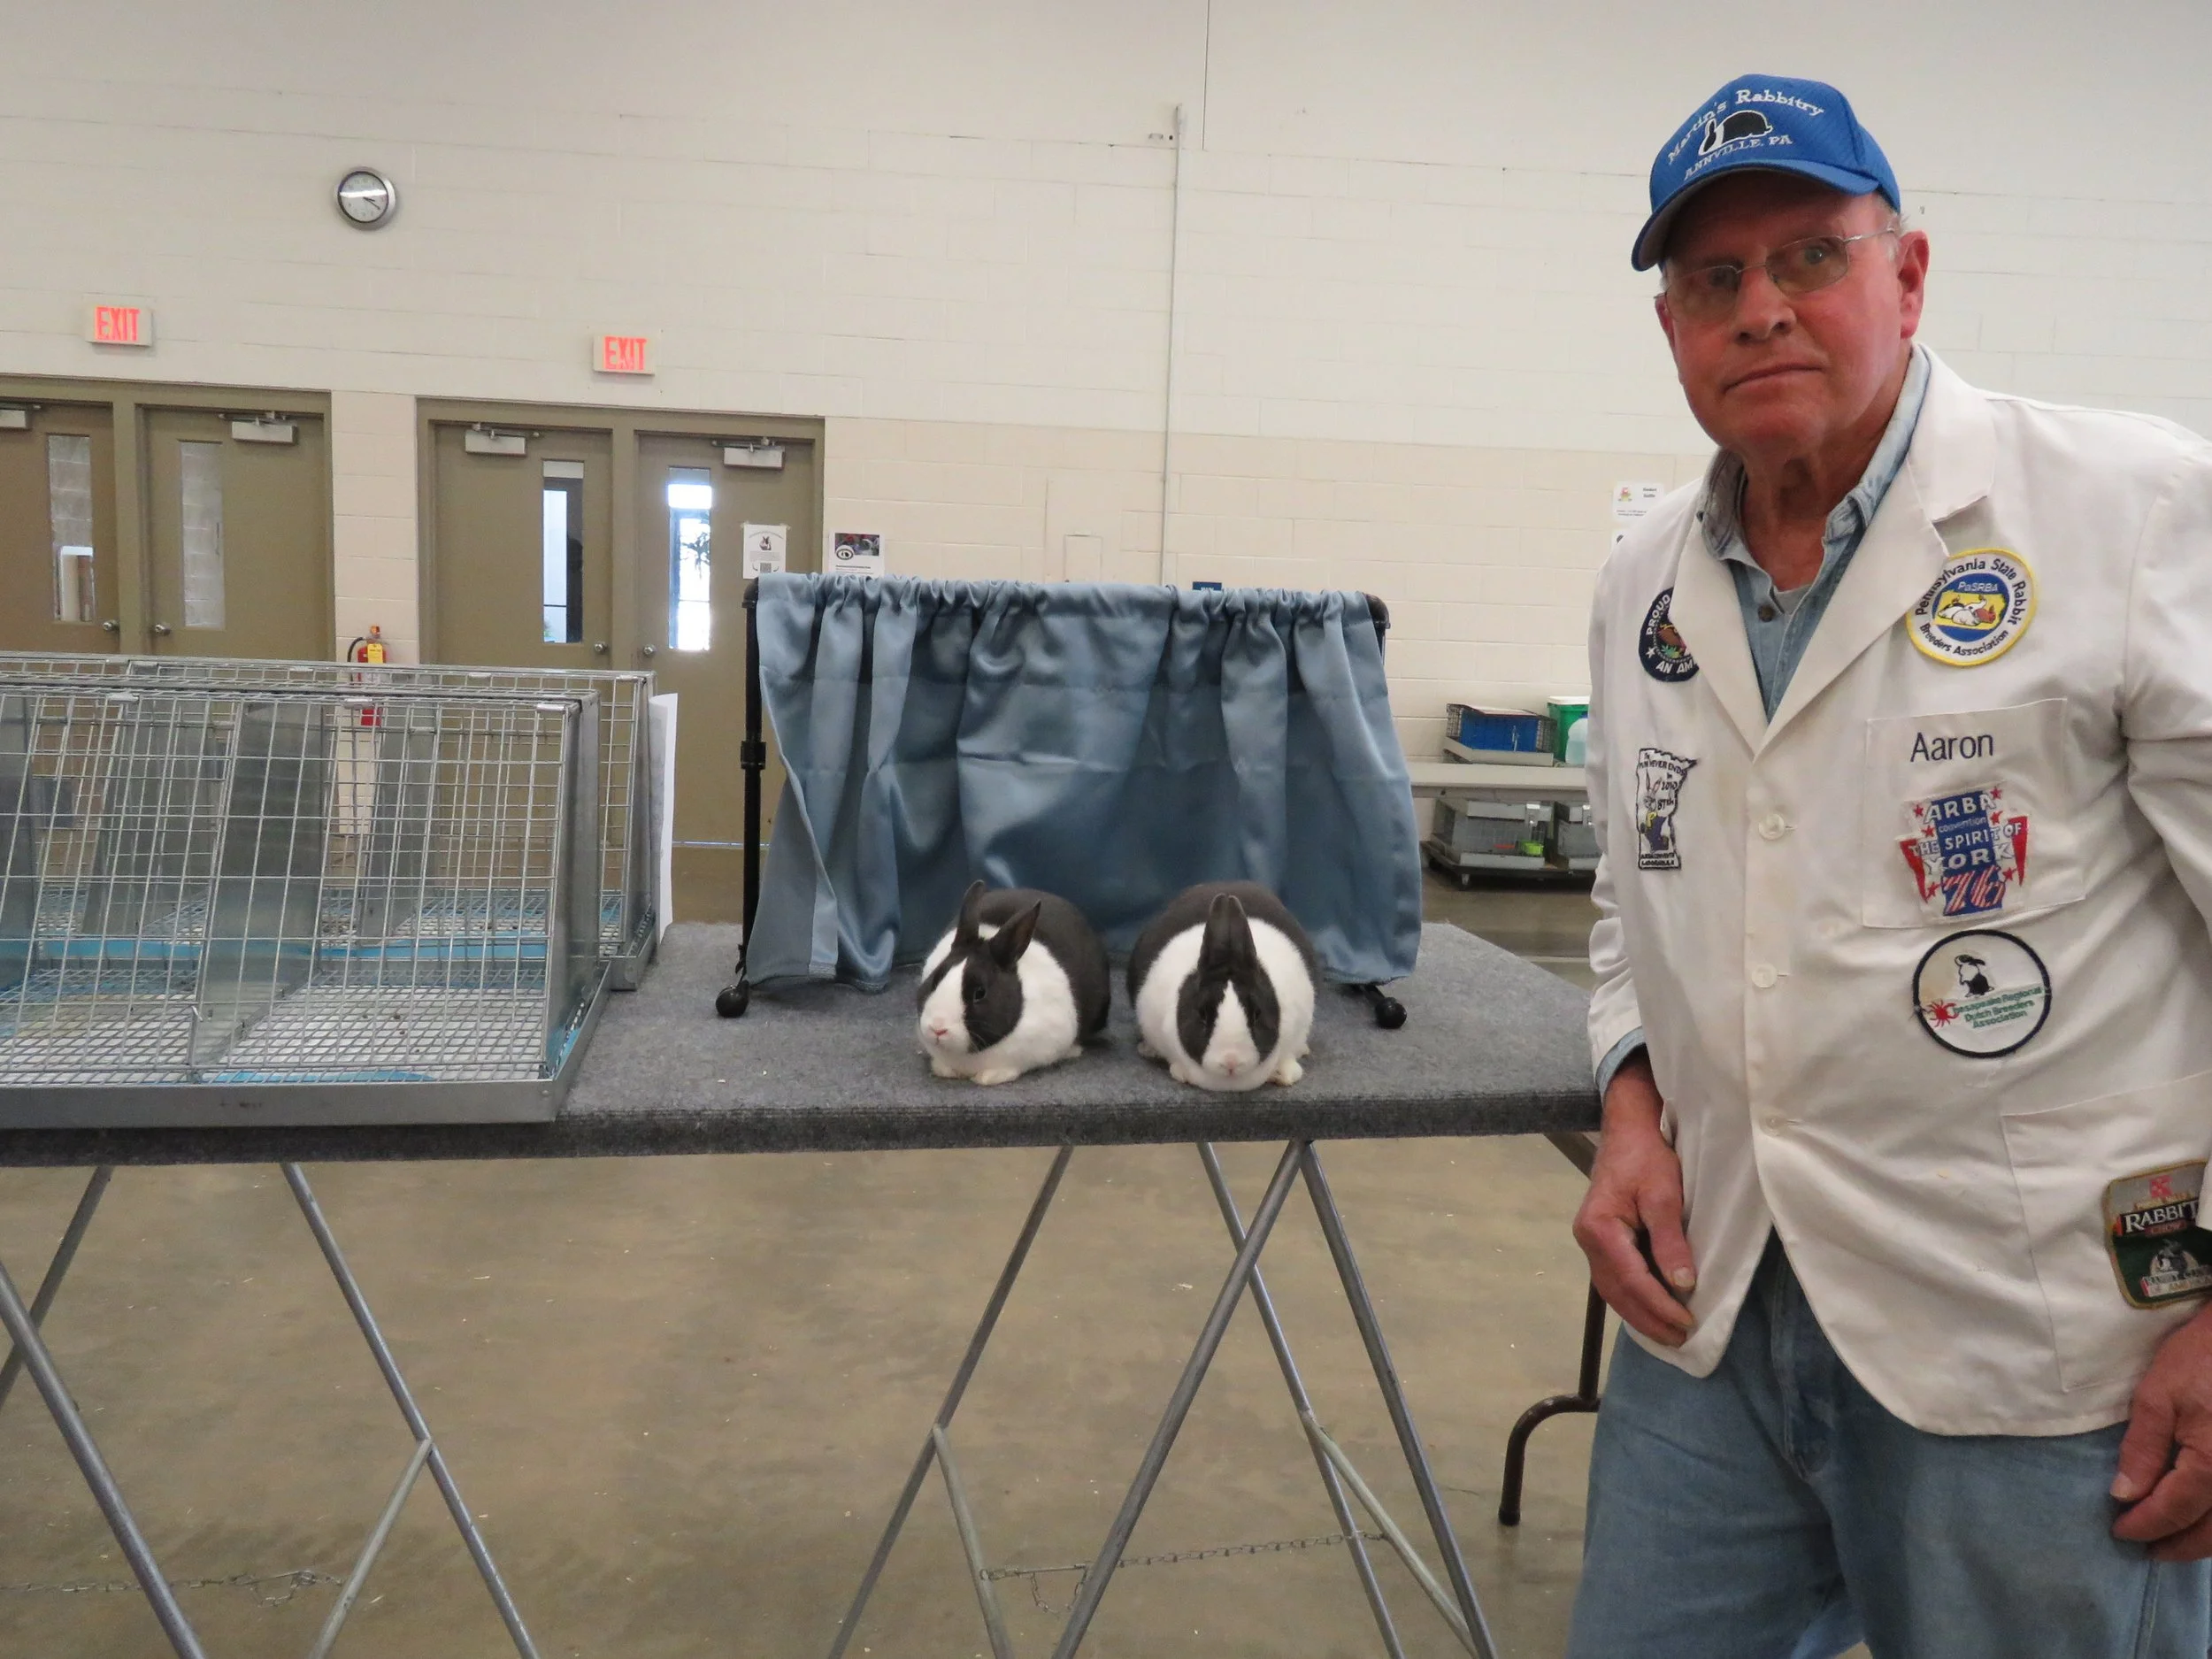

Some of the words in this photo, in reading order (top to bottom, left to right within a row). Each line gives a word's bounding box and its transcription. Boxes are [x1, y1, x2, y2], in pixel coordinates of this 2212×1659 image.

[1735, 89, 1824, 116] Rabbitry
[1770, 134, 1793, 146] PA
[96, 306, 140, 341] EXIT
[603, 336, 647, 371] EXIT
[1915, 558, 1985, 616] Pennsylvania
[1991, 558, 2017, 580] State
[2008, 580, 2027, 626] Rabbit
[1646, 594, 1671, 635] PROUD
[1920, 623, 1952, 652] Breeders
[1953, 629, 2009, 657] Association
[1655, 660, 1673, 674] AN
[1676, 657, 1696, 674] AM
[1910, 732, 1993, 762] Aaron
[1924, 794, 1996, 825] ARBA
[1909, 840, 1940, 856] THE
[1945, 826, 2000, 850] SPIRIT
[2003, 822, 2023, 838] OF
[1924, 842, 2015, 875] YORK
[1942, 864, 2007, 916] 76
[1965, 1010, 1992, 1022] Dutch
[1992, 1000, 2034, 1016] Breeders
[1973, 1010, 2027, 1028] Association
[2125, 1200, 2198, 1233] RABBIT
